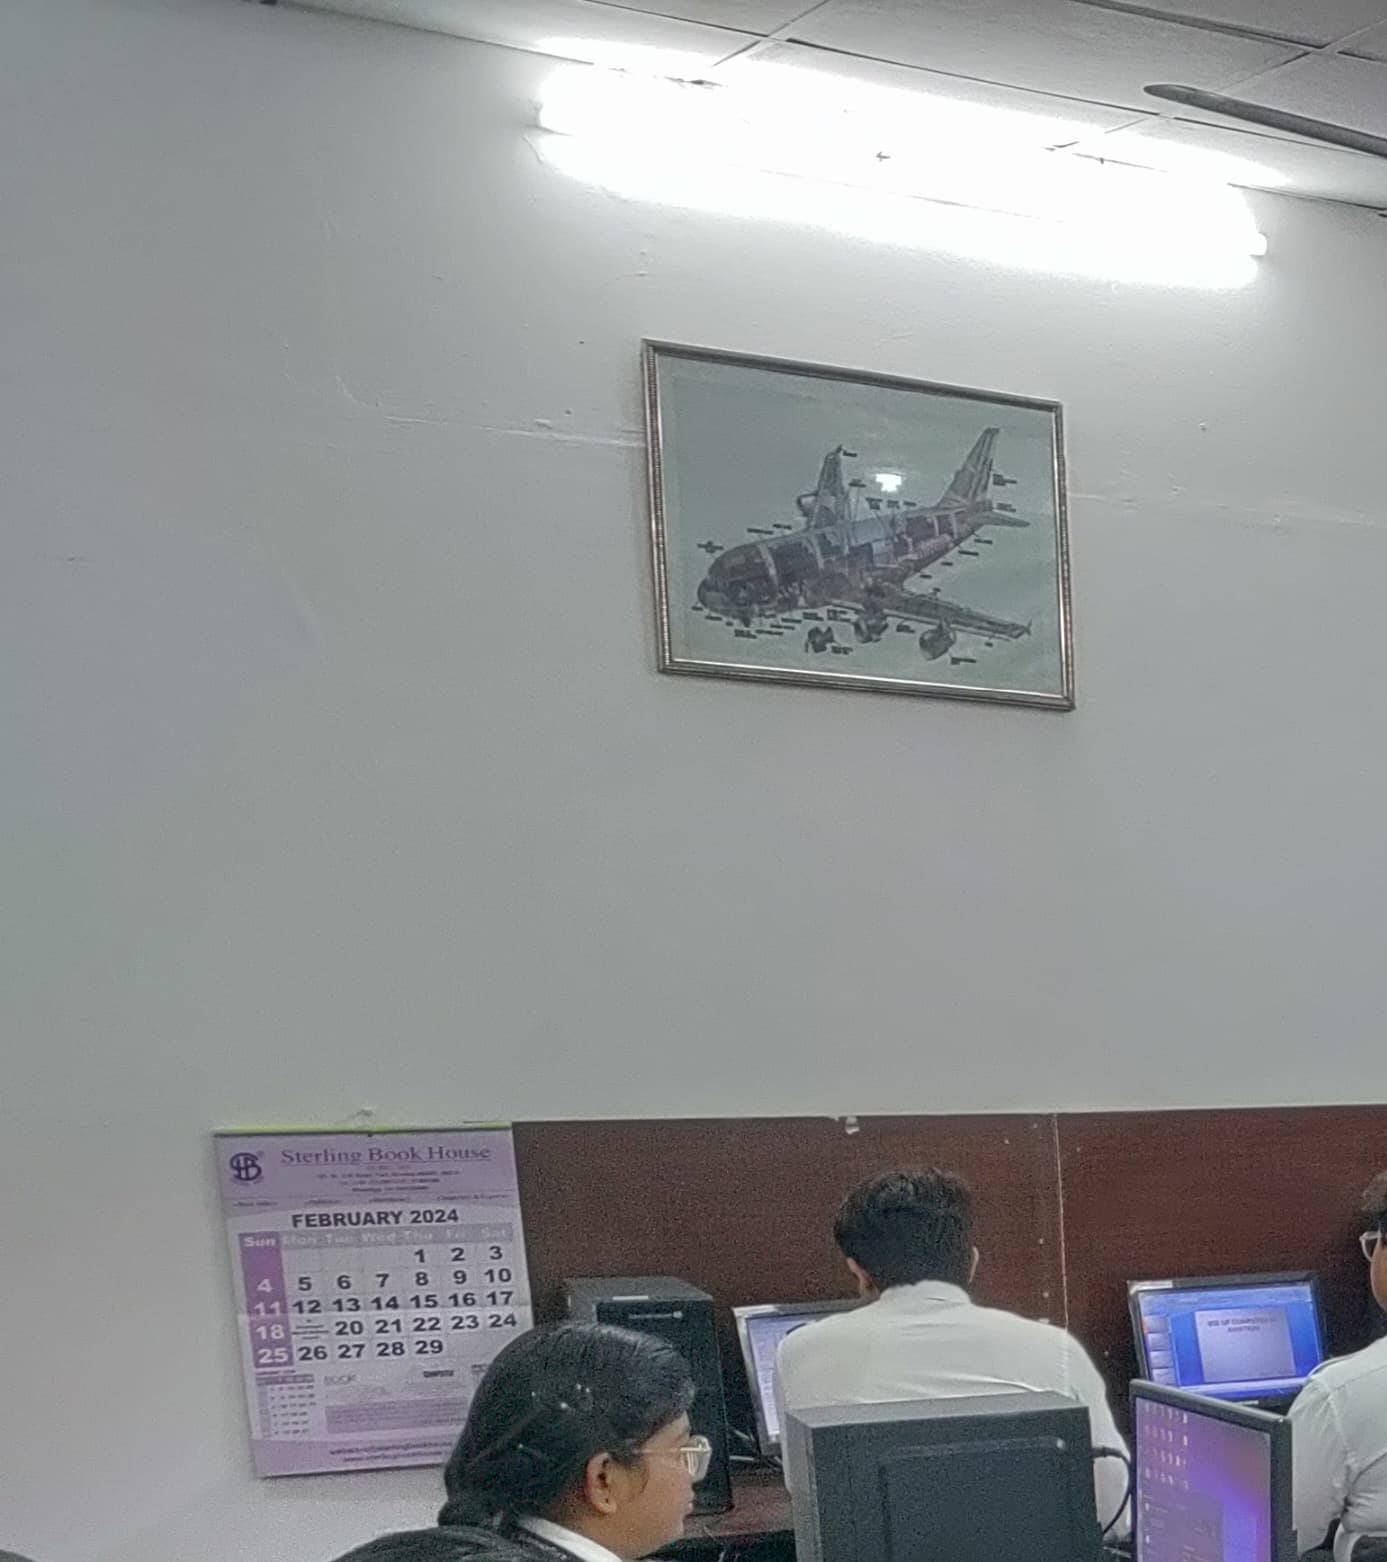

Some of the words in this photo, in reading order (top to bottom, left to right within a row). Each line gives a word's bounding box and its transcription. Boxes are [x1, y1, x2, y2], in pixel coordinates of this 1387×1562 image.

[281, 1148, 362, 1166] Sterling
[368, 1147, 424, 1163] Book
[427, 1146, 491, 1162] House
[291, 1211, 403, 1228] FEBRUARY
[410, 1209, 459, 1224] 2024
[244, 1236, 276, 1247] Sun
[414, 1249, 425, 1263] 1
[451, 1247, 465, 1262] 2
[489, 1246, 503, 1260] 3
[257, 1278, 272, 1292] 4
[298, 1277, 312, 1291] 5
[337, 1275, 351, 1290] 6
[376, 1273, 389, 1288] 7
[415, 1272, 429, 1286] 8
[453, 1270, 467, 1284] 9
[484, 1268, 512, 1283] 10
[254, 1301, 281, 1316] 11
[292, 1300, 322, 1314] 12
[332, 1298, 361, 1312] 13
[371, 1296, 400, 1310] 14
[410, 1294, 438, 1309] 15
[448, 1292, 476, 1307] 16
[486, 1291, 514, 1306] 17
[256, 1325, 284, 1340] 18
[335, 1320, 363, 1336] 20
[375, 1319, 402, 1334] 21
[413, 1317, 441, 1332] 22
[451, 1315, 479, 1330] 23
[489, 1313, 517, 1328] 24
[258, 1348, 289, 1364] 25
[298, 1345, 328, 1361] 26
[338, 1344, 365, 1359] 27
[376, 1342, 405, 1357] 28
[415, 1340, 443, 1355] 29
